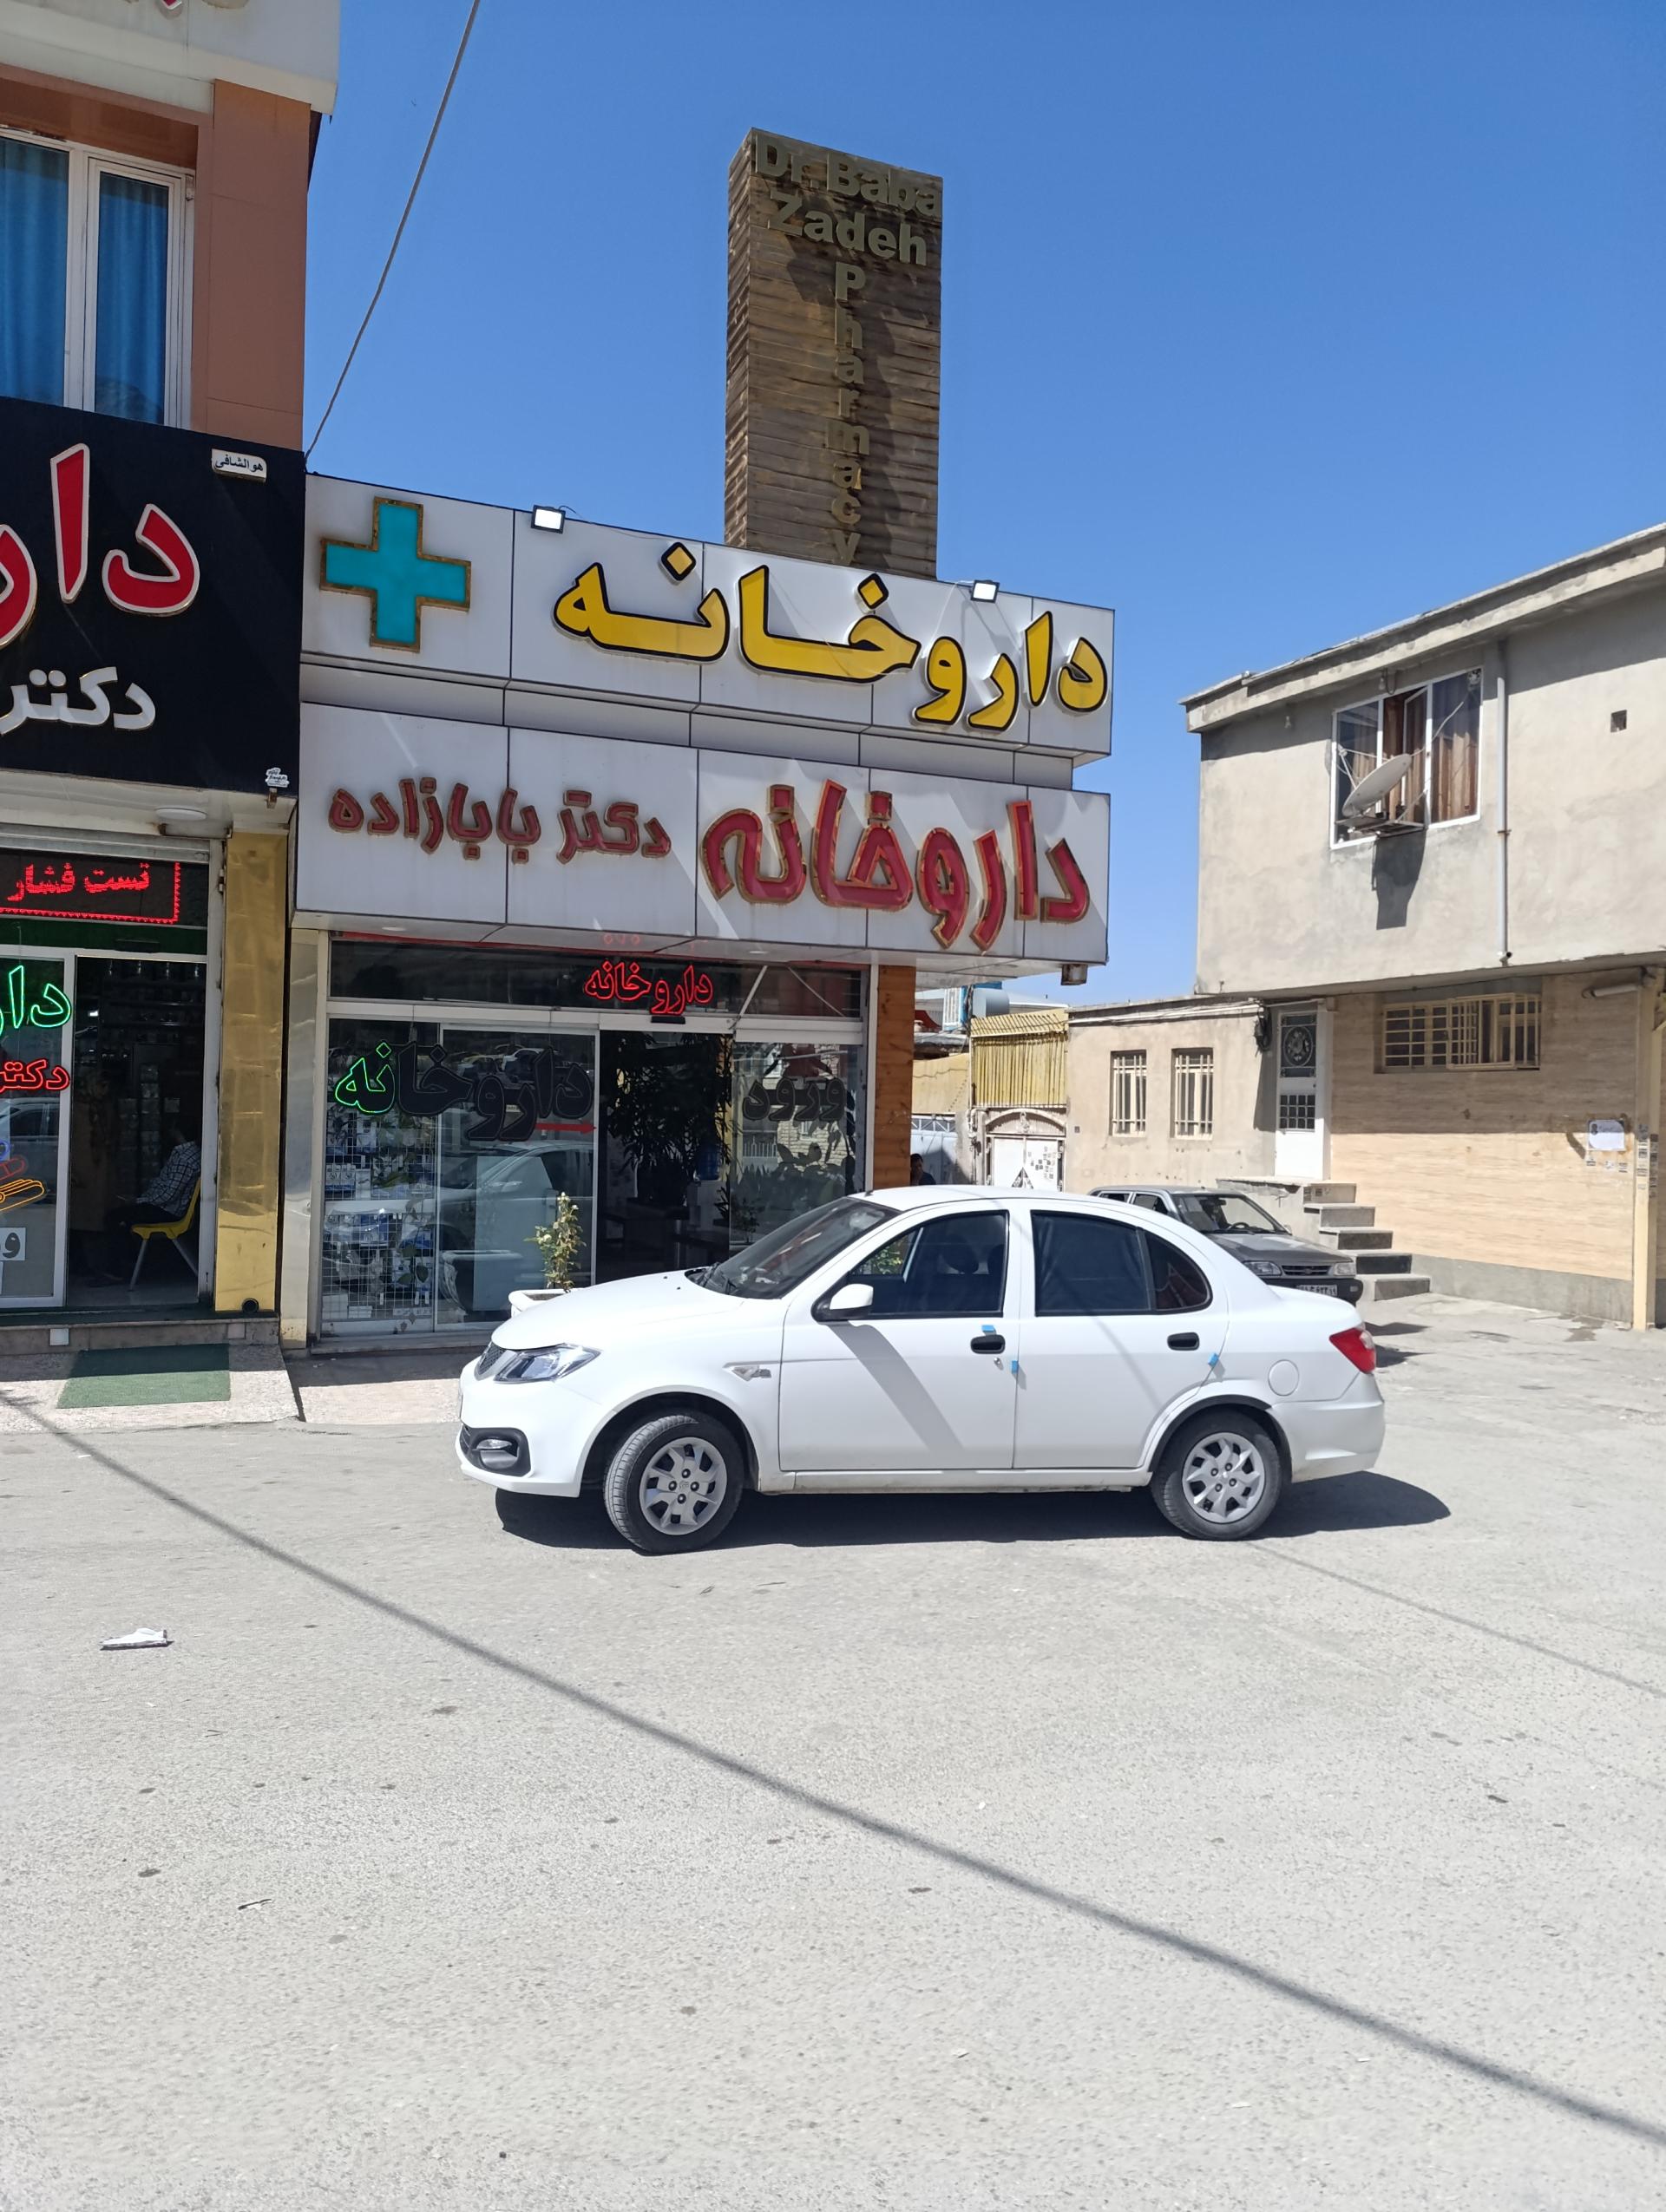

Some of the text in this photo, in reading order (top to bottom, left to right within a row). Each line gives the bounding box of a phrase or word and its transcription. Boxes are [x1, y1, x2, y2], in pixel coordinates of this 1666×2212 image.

[768, 189, 928, 266] Zadeh
[825, 261, 870, 566] Pharmacy
[553, 541, 1110, 733] داروخانه
[556, 789, 672, 865] دکتر
[701, 778, 1092, 953] داروخانه
[7, 862, 150, 902] تست فشار
[584, 959, 714, 1016] داروخانه
[334, 1040, 594, 1142] داروخانه
[742, 1076, 848, 1122] ورود
